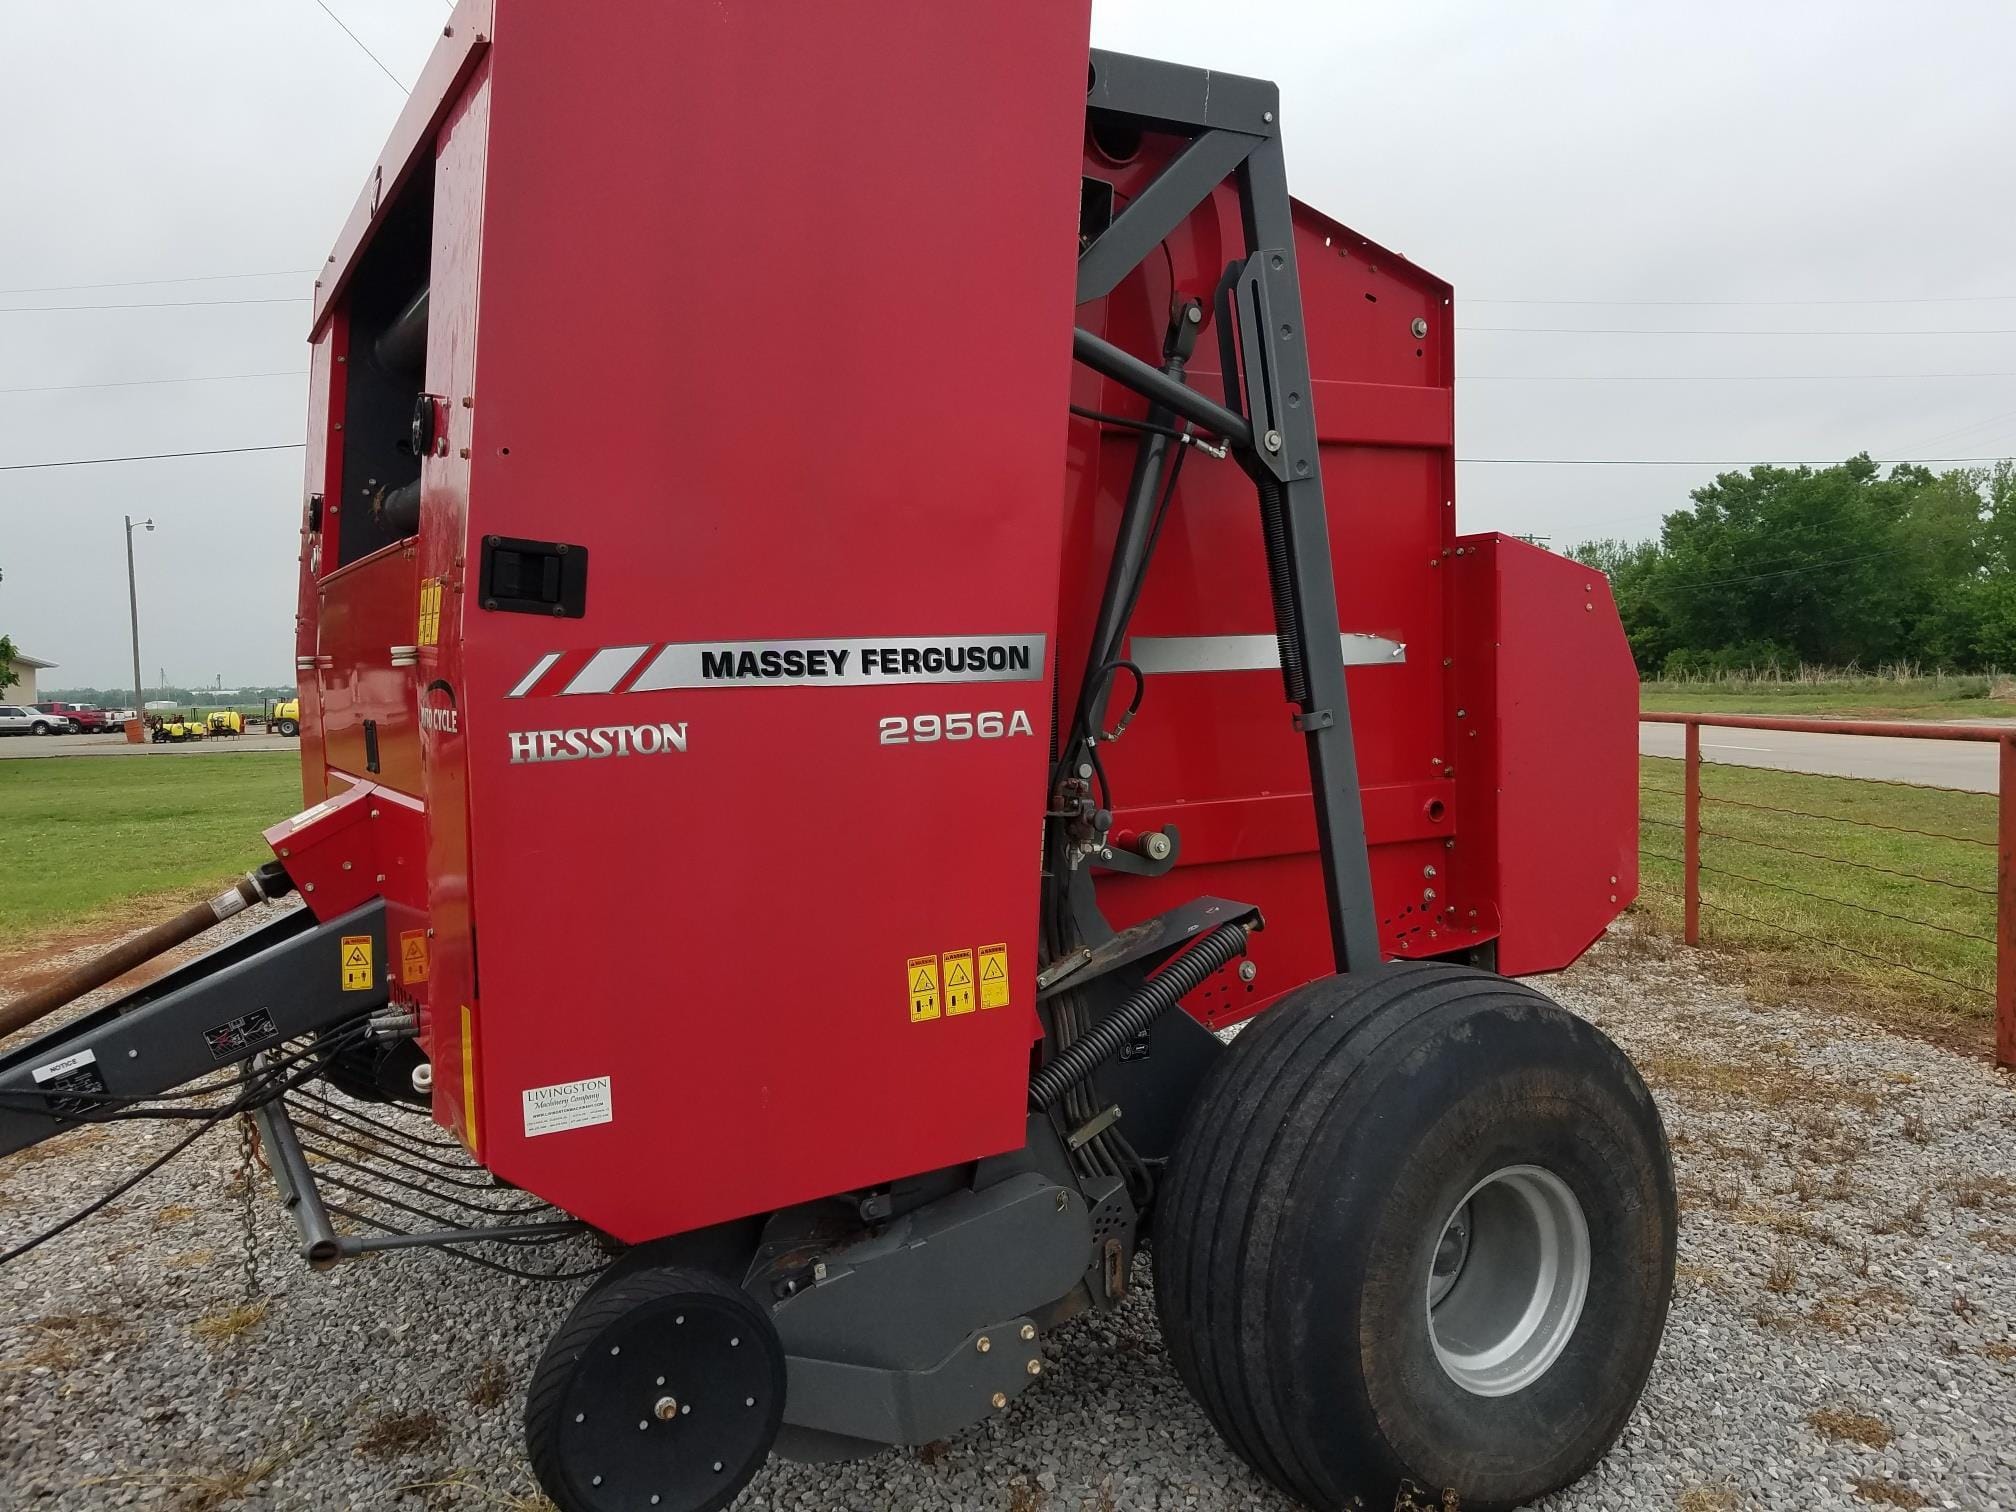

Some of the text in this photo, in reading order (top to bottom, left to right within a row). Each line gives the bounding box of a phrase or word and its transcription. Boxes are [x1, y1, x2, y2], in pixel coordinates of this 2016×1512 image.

[702, 646, 1031, 679] MASSEY FERGUSON
[434, 709, 458, 733] CYCLE
[879, 710, 1034, 745] 2956A
[508, 722, 688, 764] HESSTON
[50, 1058, 77, 1073] NOTICE
[528, 1079, 607, 1102] LIVINGSTON
[534, 1092, 600, 1110] Machinery Company
